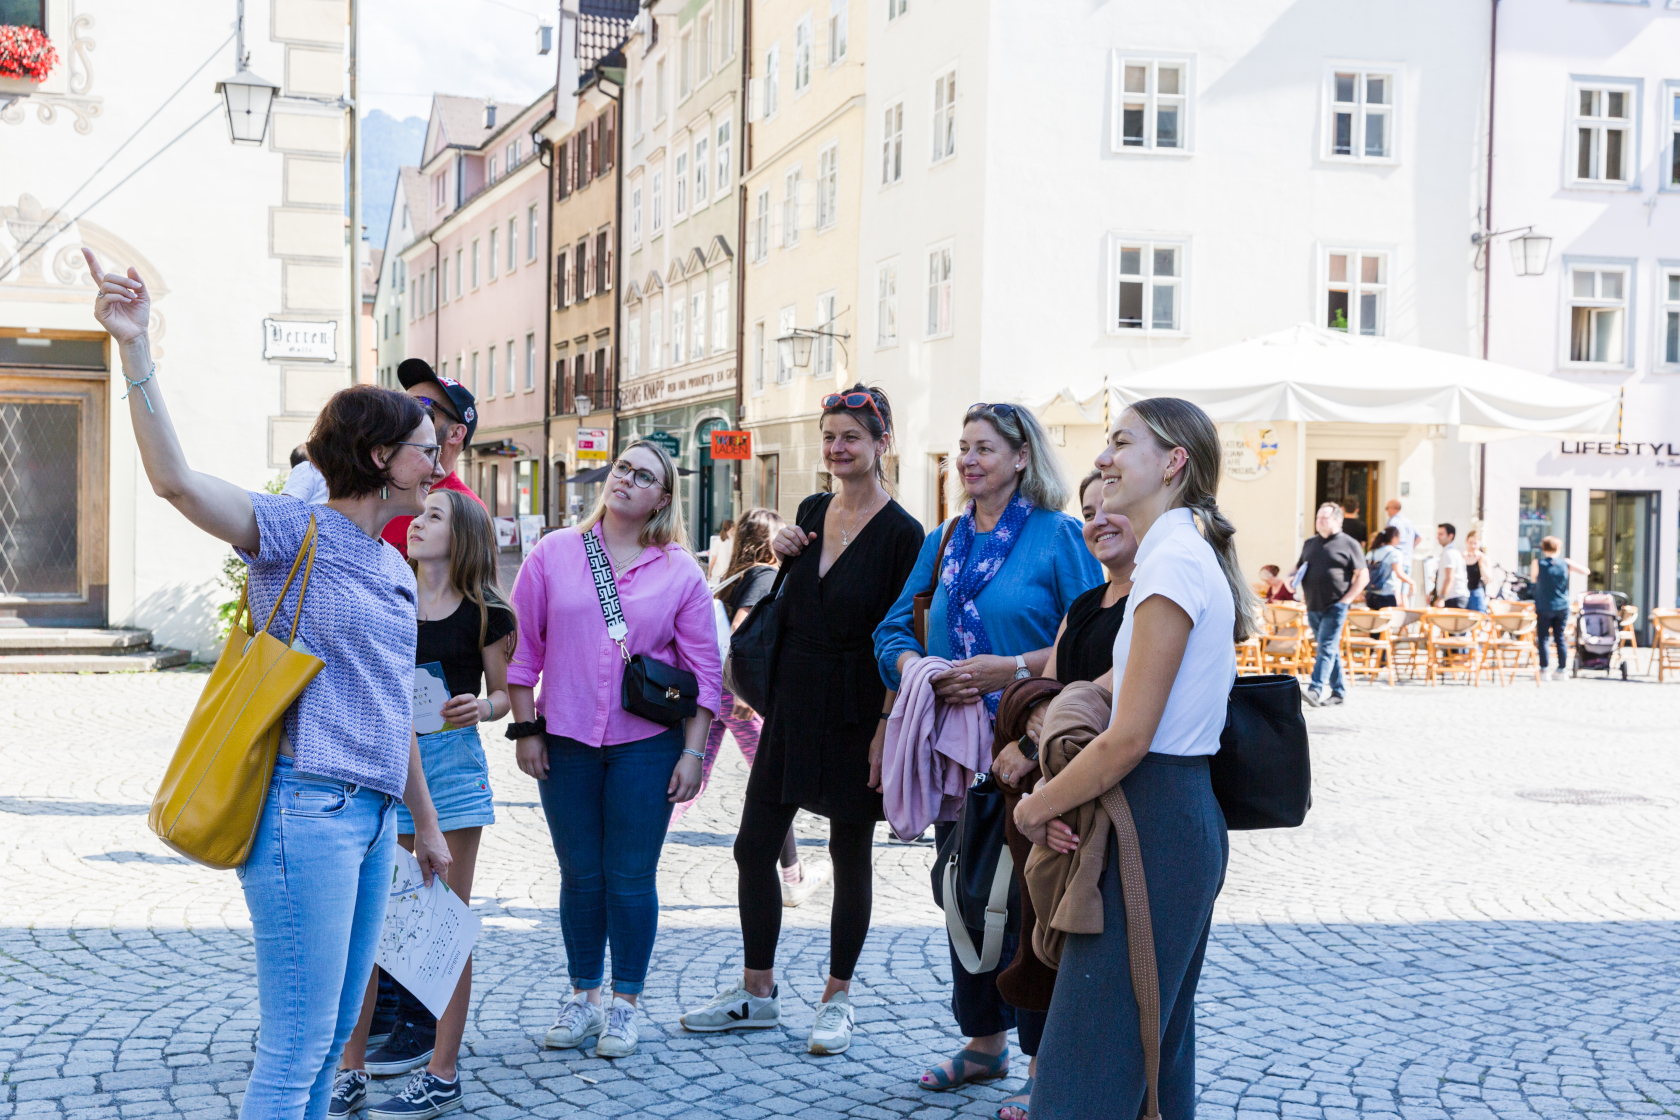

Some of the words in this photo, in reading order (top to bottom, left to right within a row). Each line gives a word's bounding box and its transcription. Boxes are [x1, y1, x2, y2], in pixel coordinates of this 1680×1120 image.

[643, 379, 665, 402] KNAPP
[715, 434, 749, 446] WELT
[714, 445, 748, 454] LADEN
[1561, 441, 1680, 456] LIFESTYL
